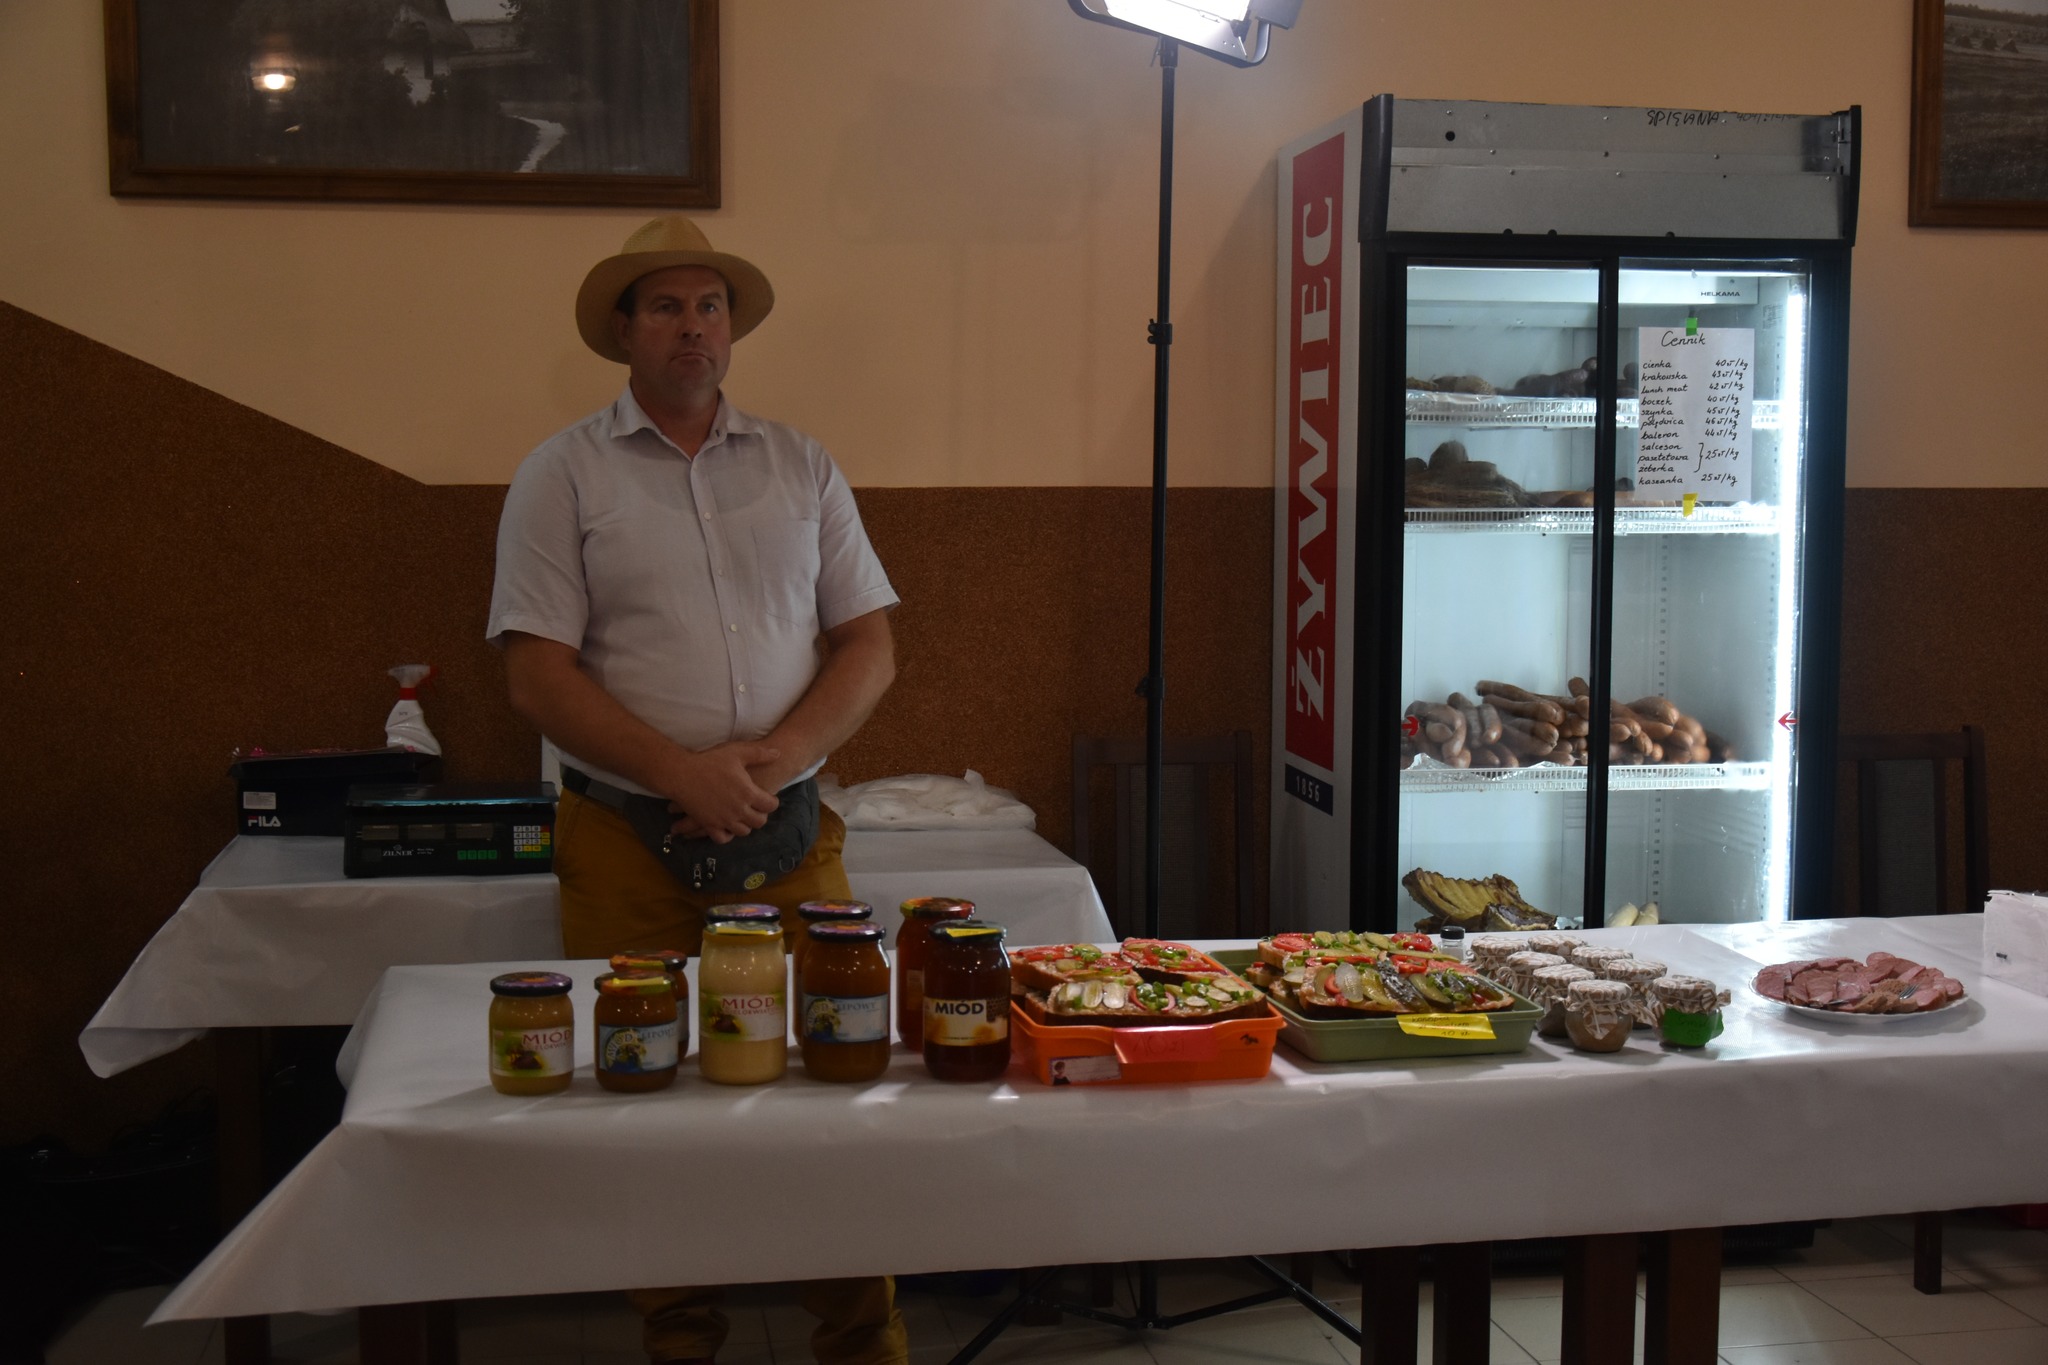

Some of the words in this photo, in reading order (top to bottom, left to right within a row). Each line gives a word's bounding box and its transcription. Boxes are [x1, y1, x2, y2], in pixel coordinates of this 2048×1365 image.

[1661, 330, 1706, 347] Cennik
[1643, 360, 1672, 369] cienka
[1641, 371, 1688, 381] krakowska
[1667, 384, 1688, 392] meat
[1641, 396, 1673, 406] boczek
[1641, 408, 1674, 417] szynka
[1641, 431, 1679, 440] baleron
[1641, 443, 1682, 451] salceson
[1291, 196, 1334, 721] ŻYWIEC
[1637, 453, 1689, 464] pasztetowa
[1638, 476, 1683, 485] kaszanka
[1296, 775, 1320, 802] 1856
[248, 815, 282, 827] FILA
[722, 995, 775, 1009] MIÓD
[935, 1000, 984, 1015] MIÓD
